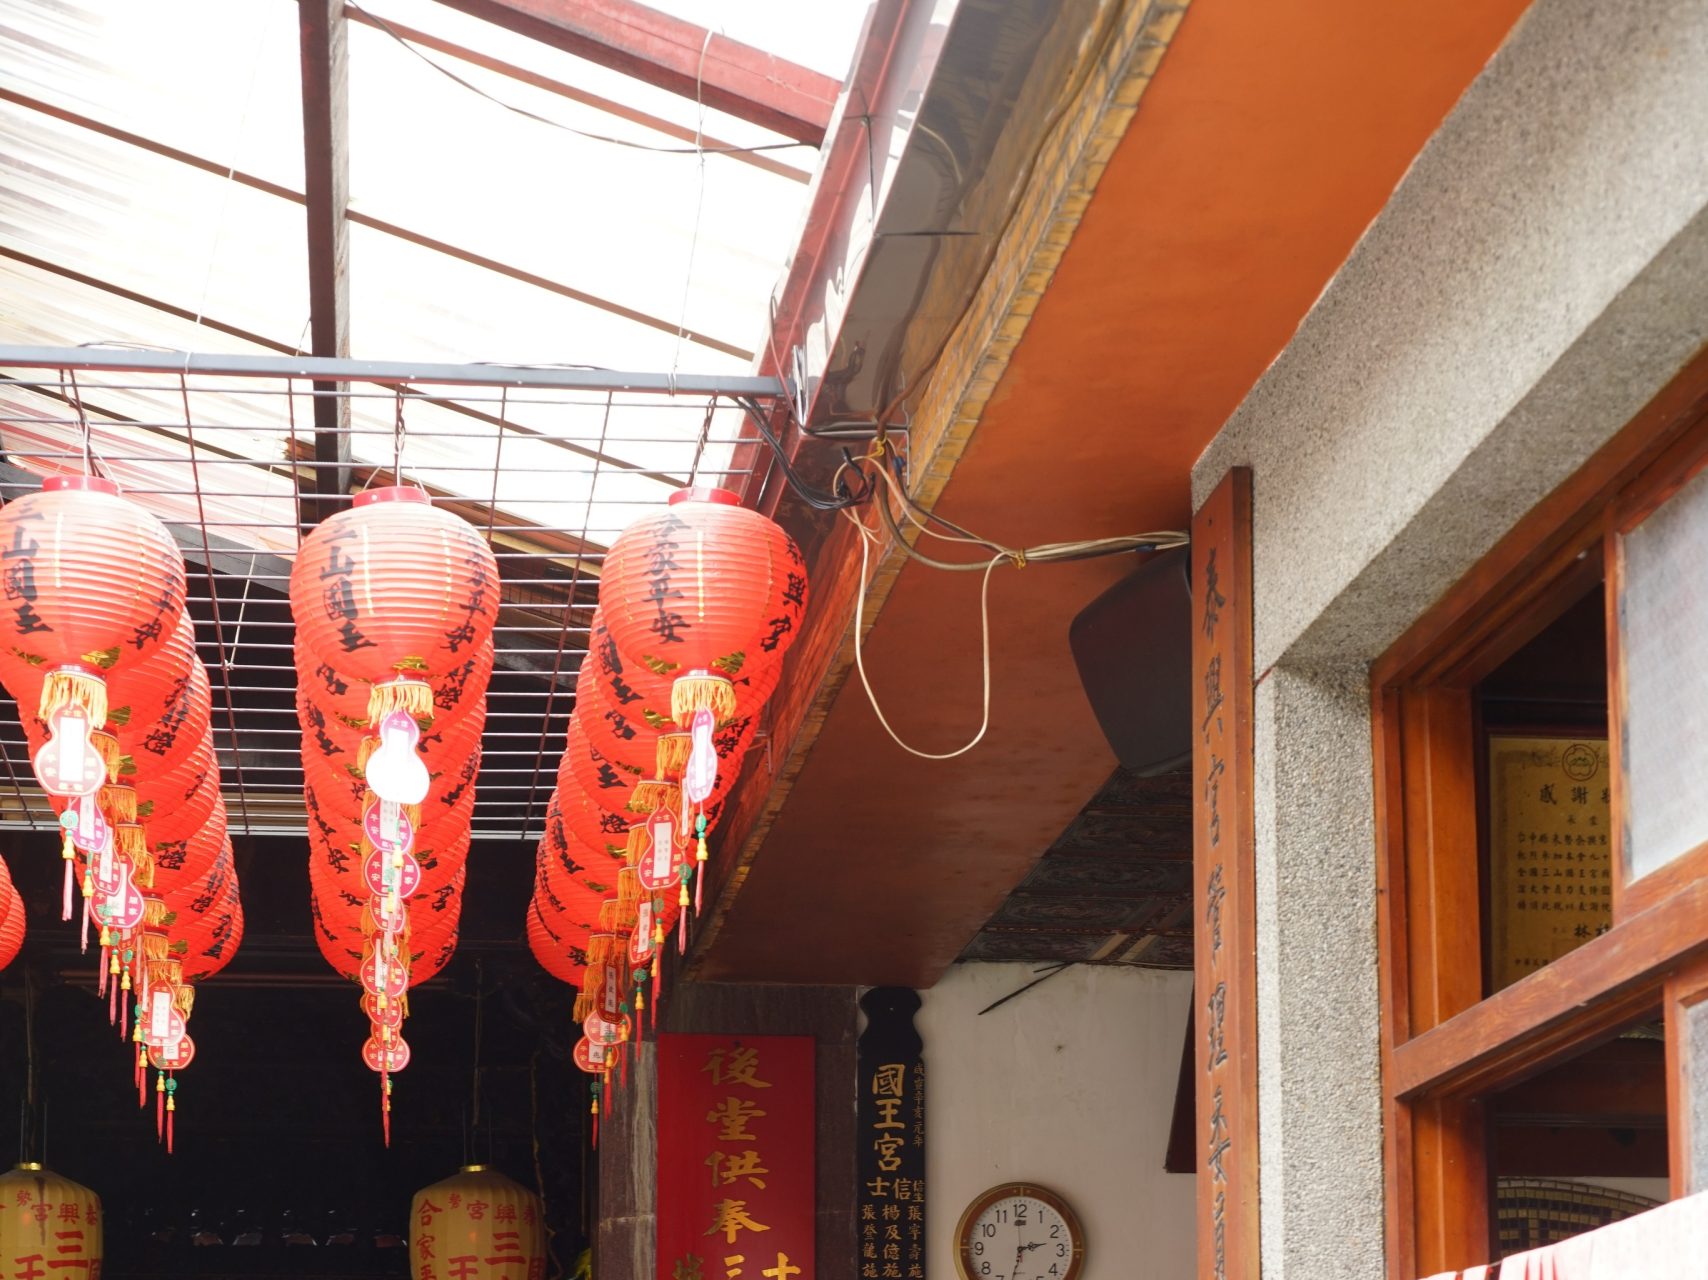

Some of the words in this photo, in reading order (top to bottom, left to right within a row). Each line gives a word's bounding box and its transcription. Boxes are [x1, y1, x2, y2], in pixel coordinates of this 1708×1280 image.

[872, 1063, 906, 1172] 國王宮
[702, 1047, 773, 1245] 後堂供奉
[996, 1210, 1007, 1223] 11
[1013, 1204, 1027, 1218] 12
[1039, 1210, 1043, 1223] 1
[982, 1224, 996, 1237] 10
[1050, 1225, 1059, 1238] 2
[974, 1242, 984, 1255] 9
[1056, 1244, 1065, 1257] 3
[981, 1262, 991, 1274] 8
[1048, 1263, 1058, 1276] 4
